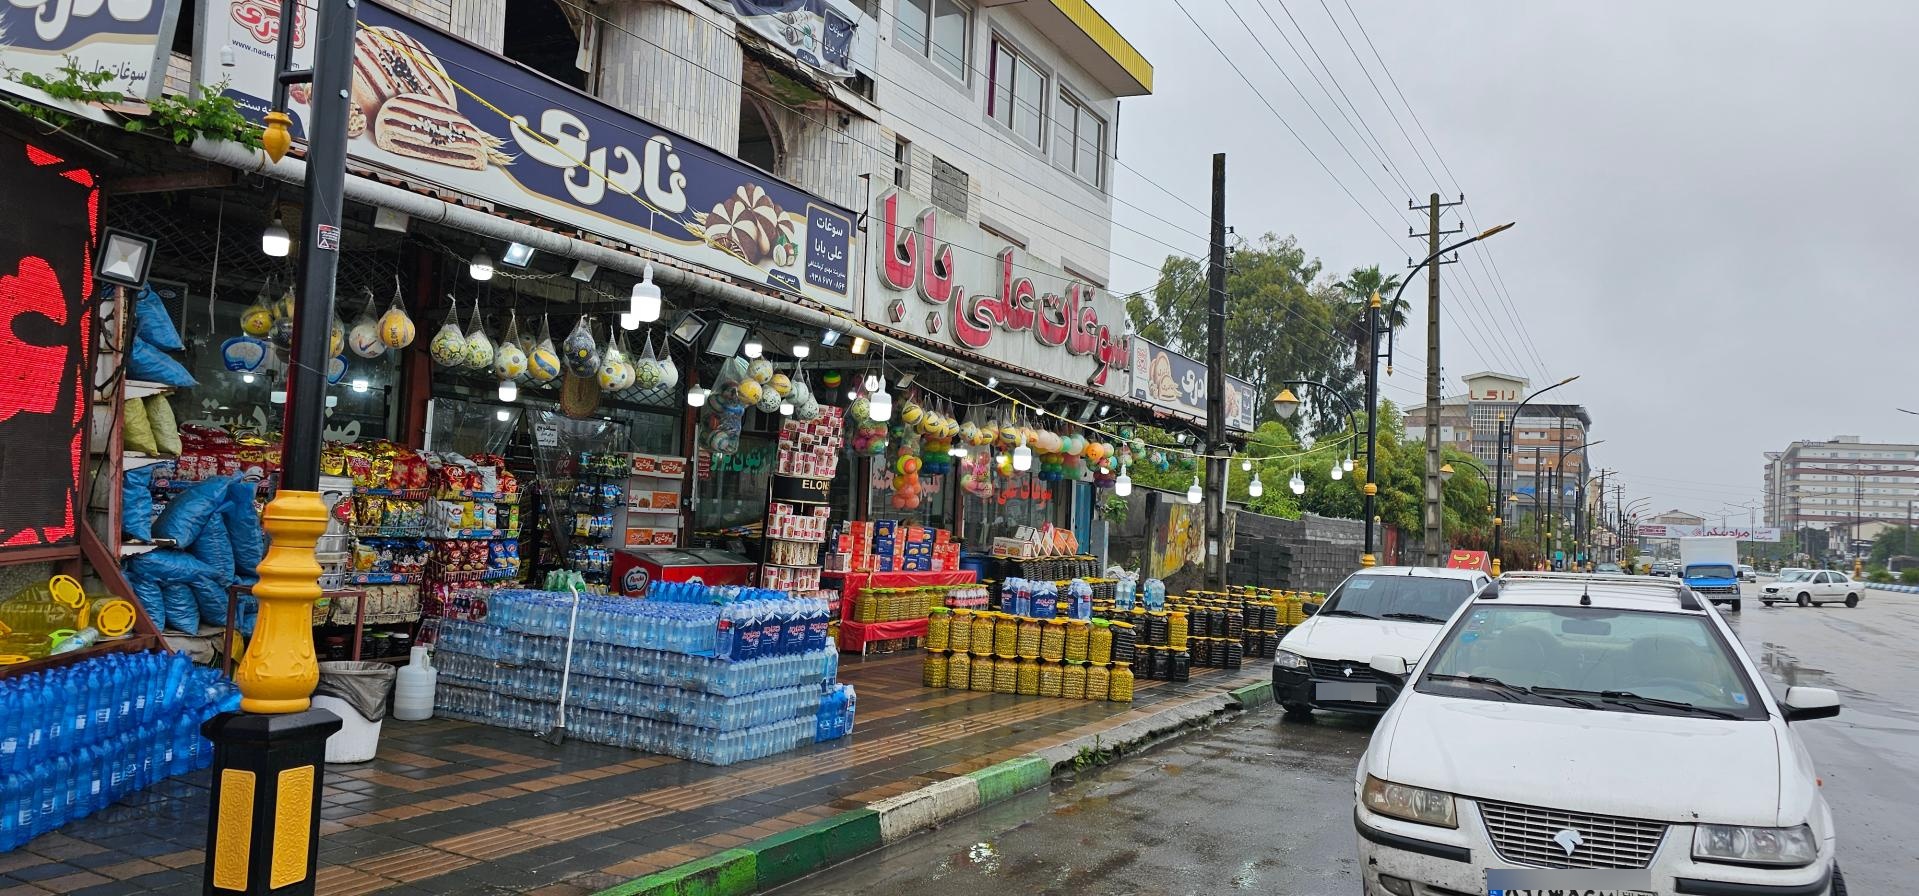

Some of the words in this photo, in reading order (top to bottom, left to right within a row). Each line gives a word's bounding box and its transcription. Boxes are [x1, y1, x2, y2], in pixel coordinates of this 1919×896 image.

[509, 108, 687, 214] نادری
[814, 238, 826, 258] بابا
[816, 217, 843, 237] سوغات
[827, 245, 843, 261] علی
[876, 184, 956, 335] بابا
[949, 246, 1036, 349] علی
[1033, 279, 1131, 387] سوغات
[1453, 553, 1480, 565] رب
